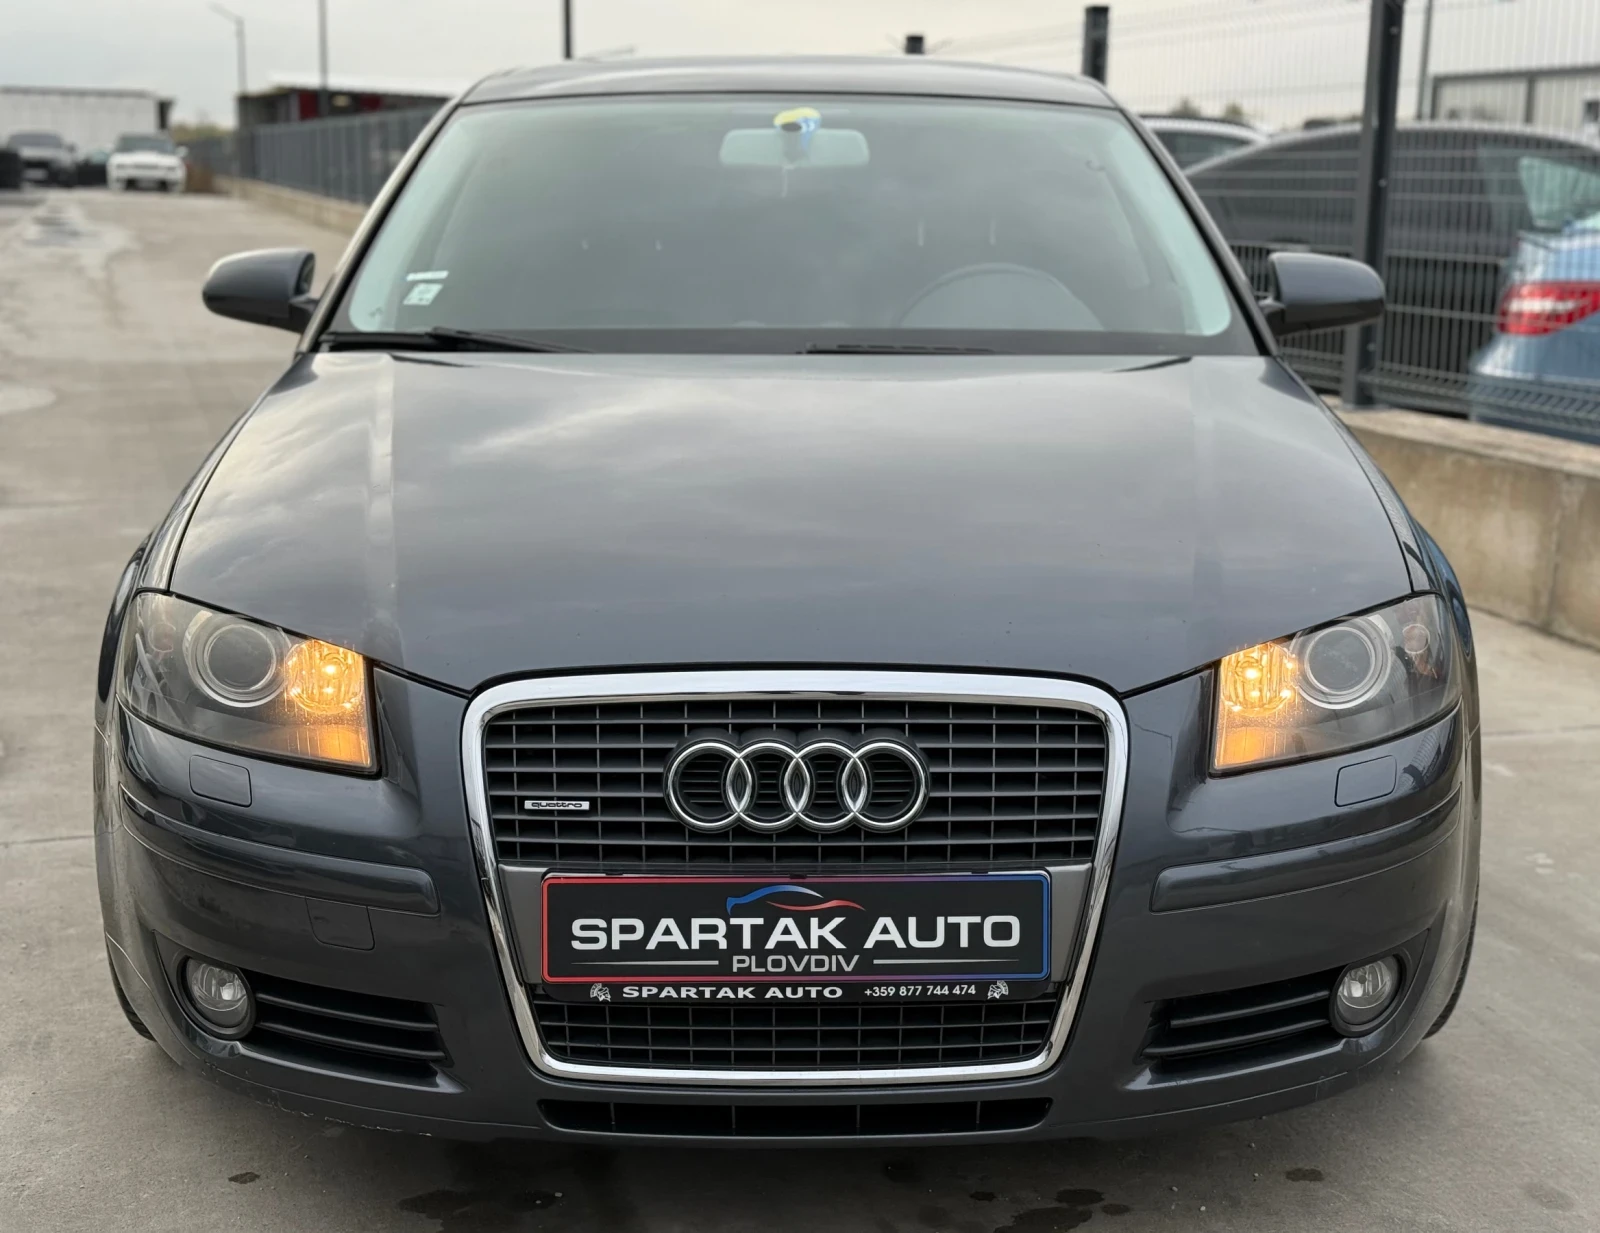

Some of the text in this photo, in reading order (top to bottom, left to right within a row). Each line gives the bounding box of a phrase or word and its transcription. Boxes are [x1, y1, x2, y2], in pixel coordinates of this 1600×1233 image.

[531, 801, 583, 809] quattro
[571, 915, 1020, 950] SPARTAK AUTO
[733, 955, 859, 972] PLOVDIV
[623, 986, 842, 998] SPARTAK AUTO
[864, 985, 976, 996] +359 877 744 474
